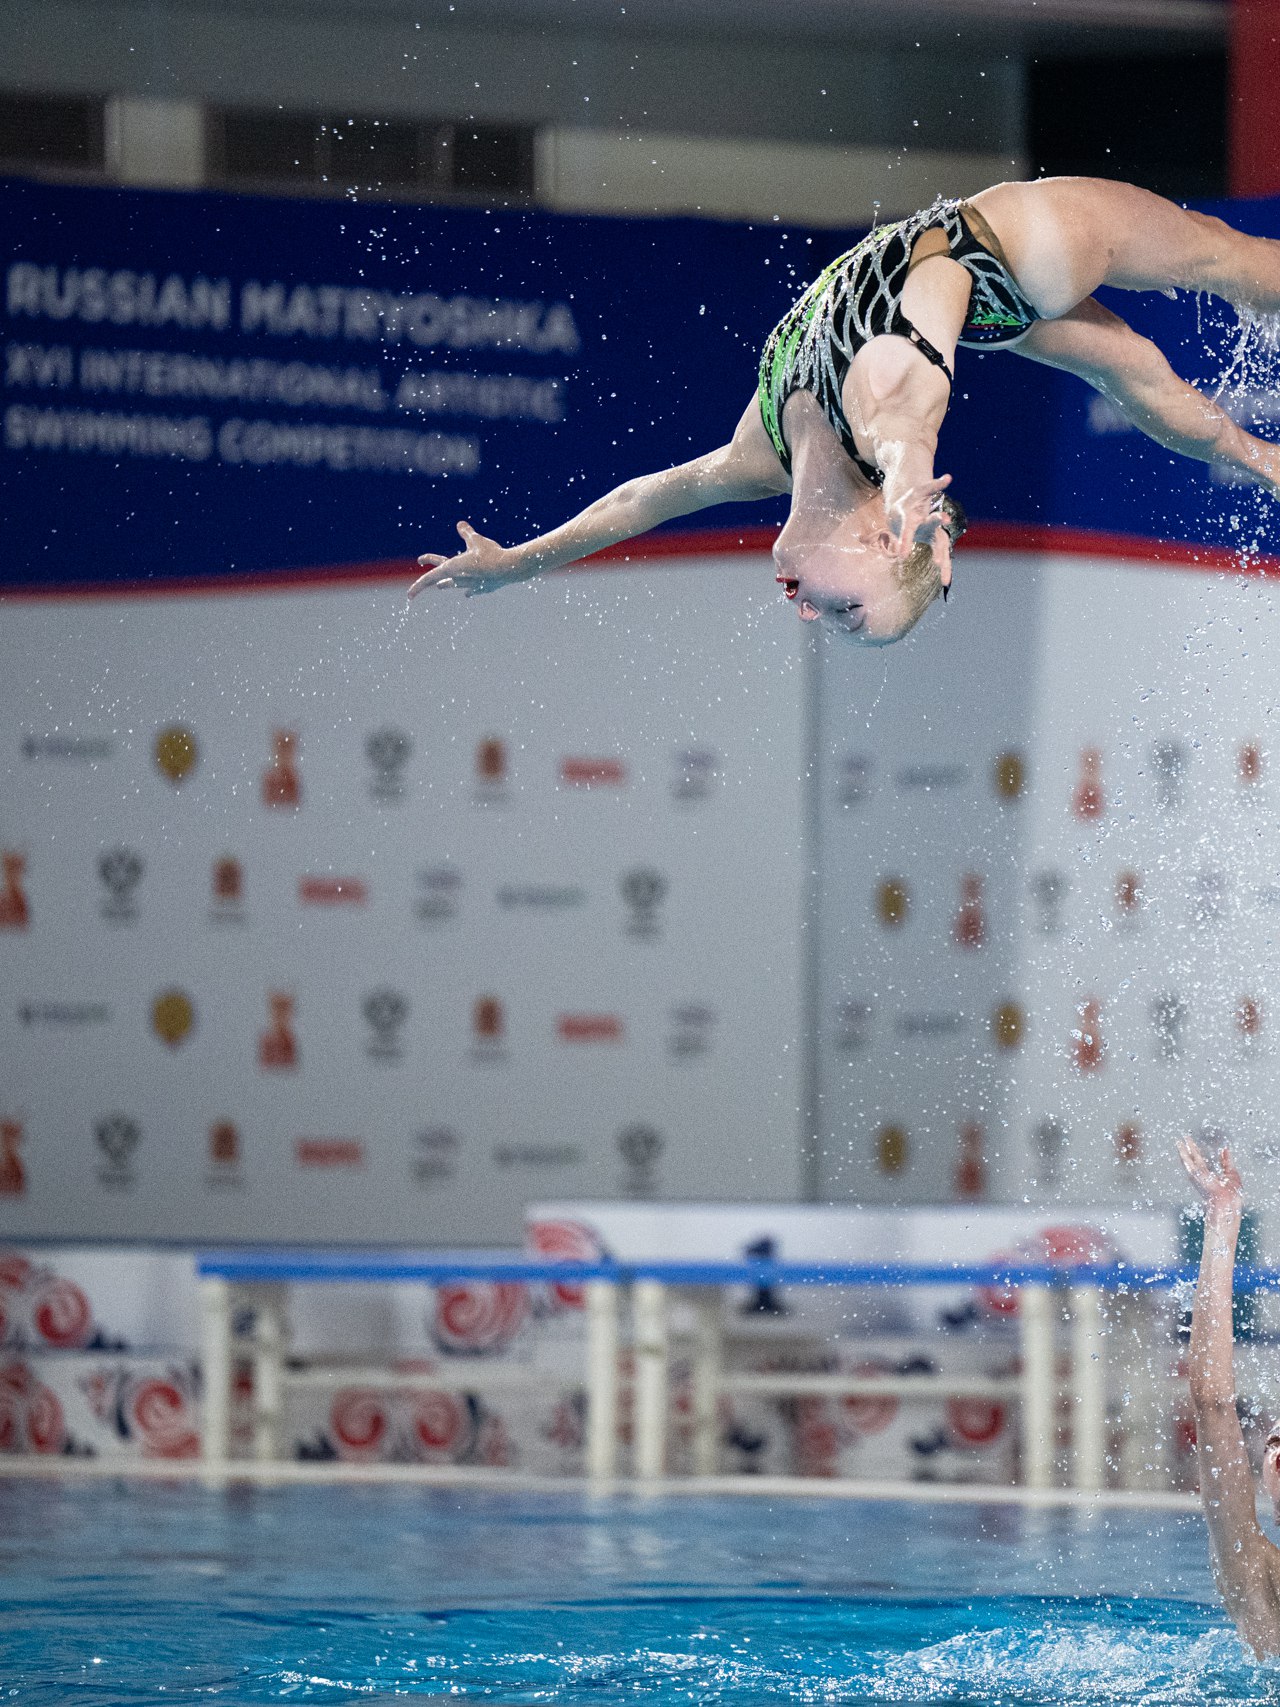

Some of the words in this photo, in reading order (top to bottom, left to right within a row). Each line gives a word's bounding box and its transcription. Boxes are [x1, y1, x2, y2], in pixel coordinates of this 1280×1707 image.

[8, 263, 231, 330] RUSSIAN
[241, 280, 579, 353] MATRYOSHKA
[81, 348, 385, 411] INTERNATIONAL
